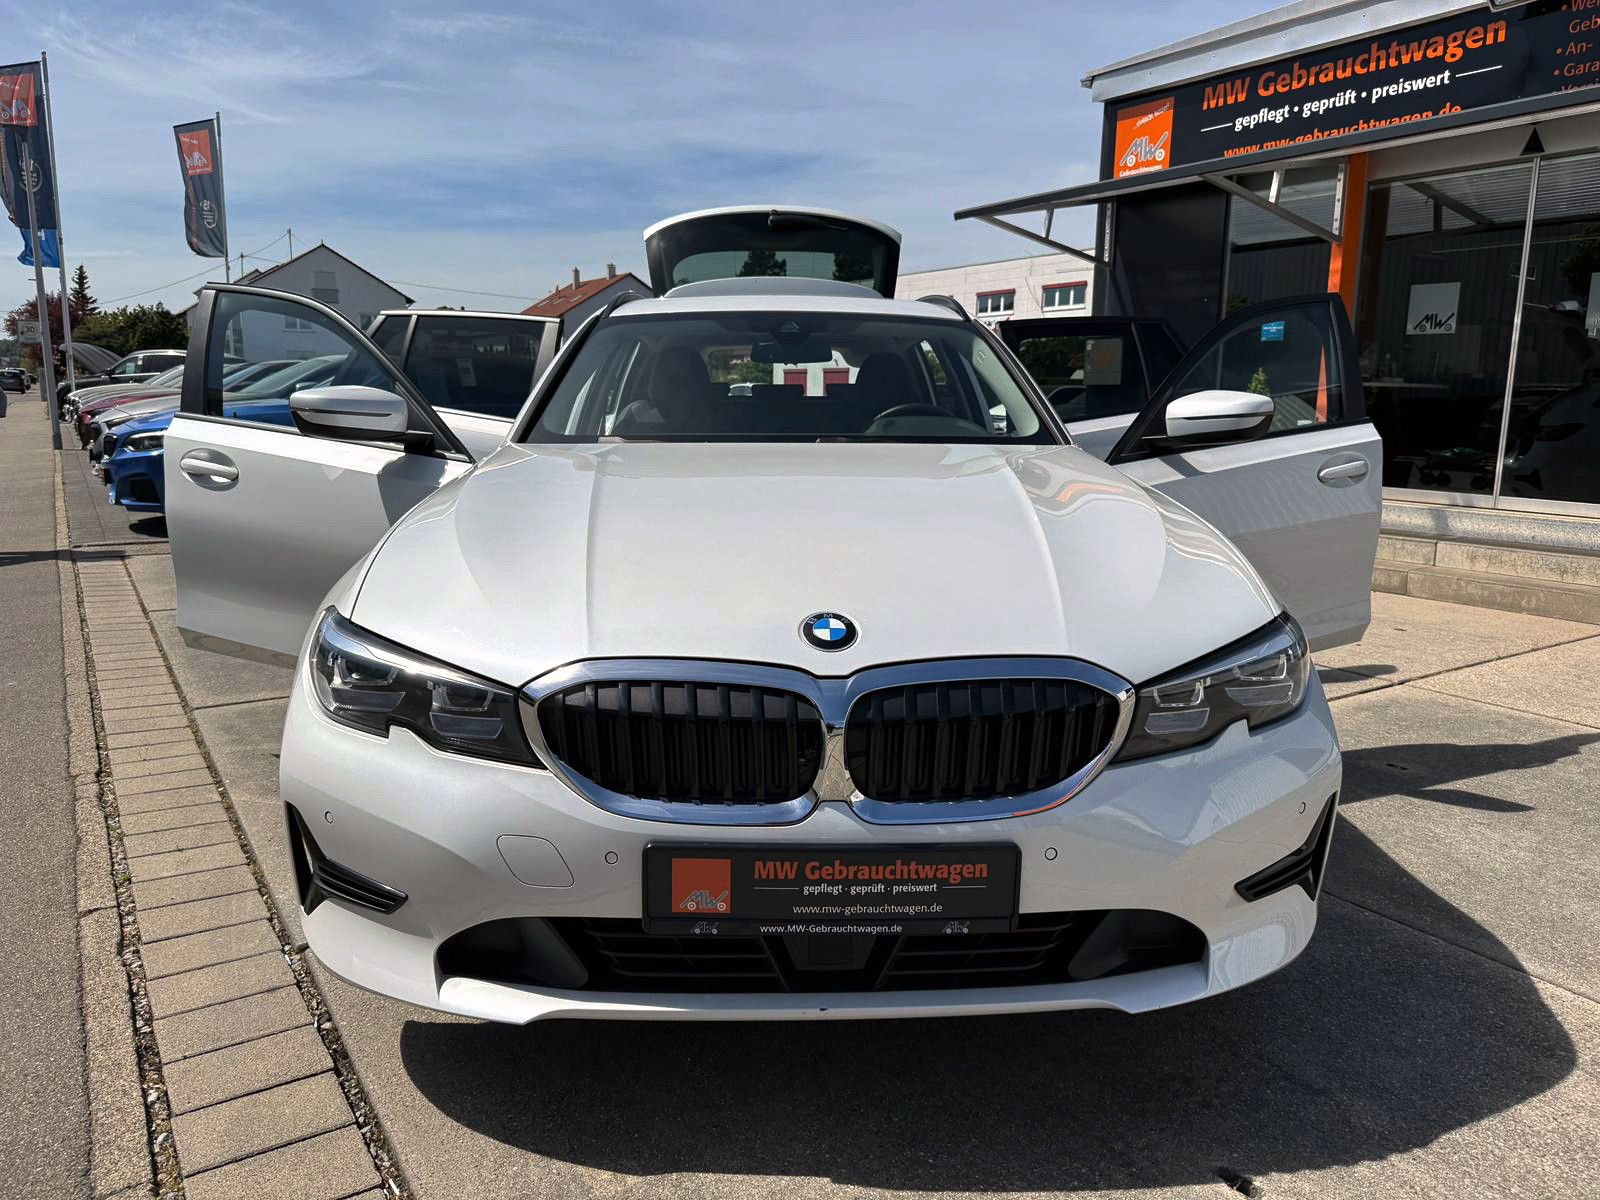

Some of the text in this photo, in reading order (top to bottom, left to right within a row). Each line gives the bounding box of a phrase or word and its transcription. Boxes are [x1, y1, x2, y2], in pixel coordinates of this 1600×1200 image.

[1565, 42, 1594, 56] An-
[1202, 20, 1507, 110] MW Gebrauchtwagen
[1564, 61, 1600, 76] Gara
[1234, 70, 1450, 132] gepflegt geprüft preiswert
[1223, 102, 1462, 158] wwwmw-ebrauchtwaende
[807, 613, 850, 625] BMW
[754, 859, 988, 884] MW Gebrauchtwagen
[803, 883, 937, 895] gepflegt geprüft preiswert
[792, 903, 943, 915] www.mw-gebrauchtwagen.de
[760, 924, 903, 935] www.MW-Gebrauchtwagen.de
